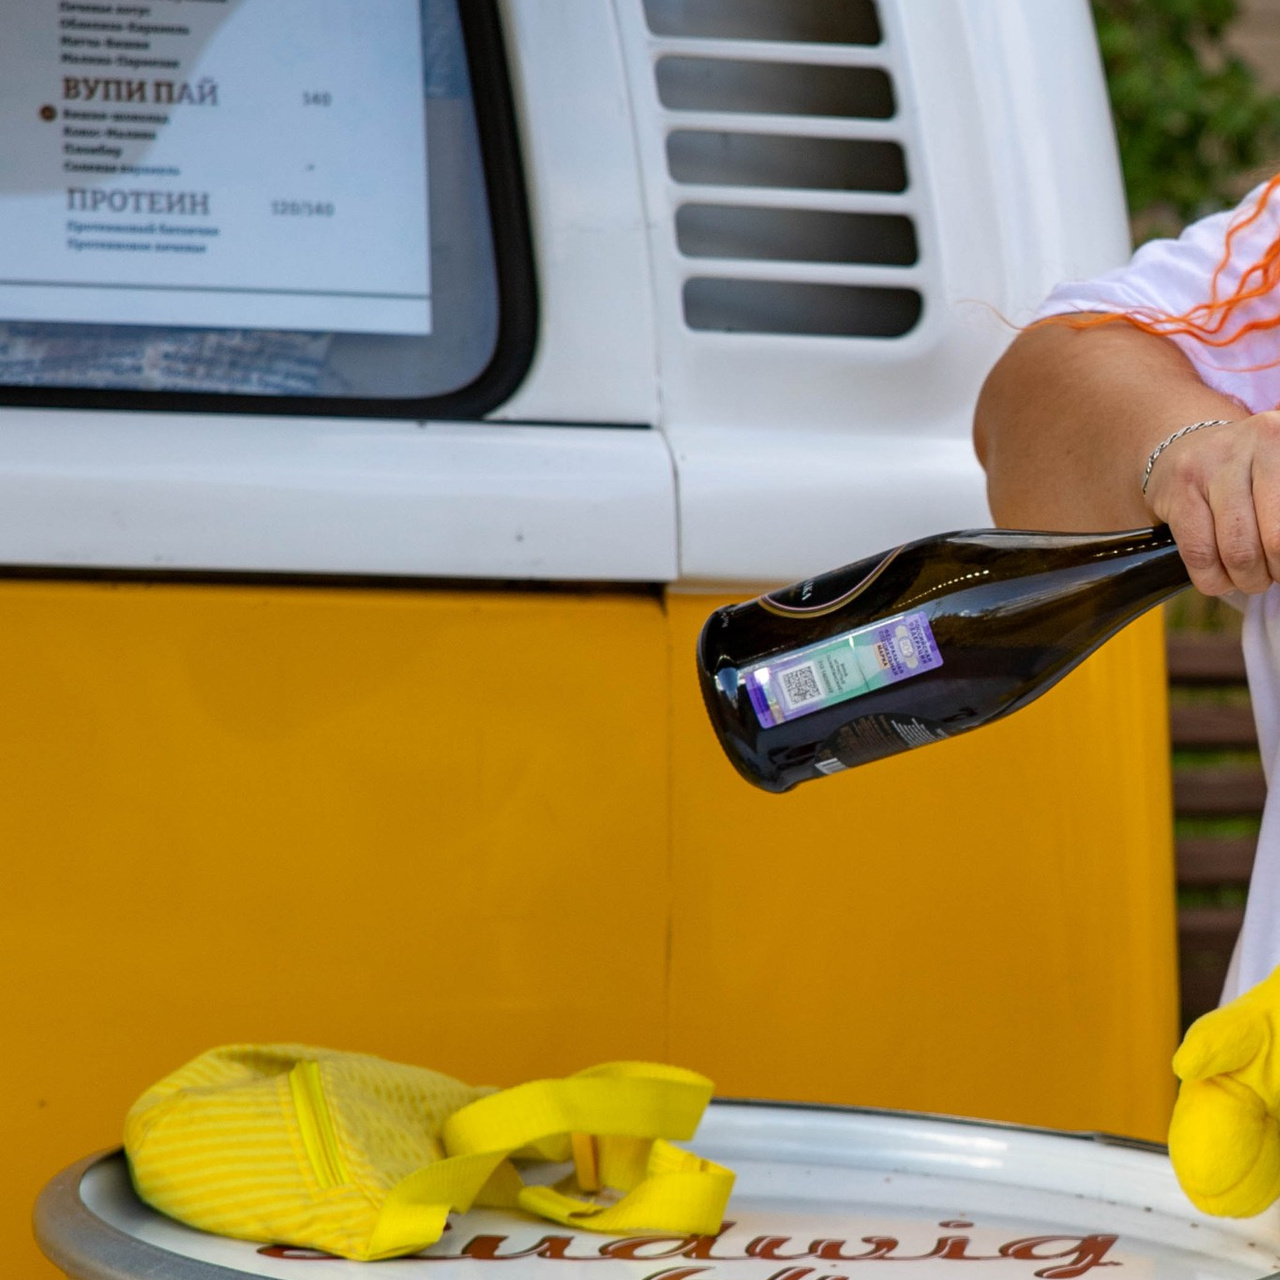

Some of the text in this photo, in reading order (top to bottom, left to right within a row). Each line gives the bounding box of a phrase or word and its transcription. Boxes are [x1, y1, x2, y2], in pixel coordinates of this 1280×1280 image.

[62, 76, 219, 107] ВУПИ ПАЙ
[66, 187, 211, 217] ПРОТЕИН
[256, 1220, 1123, 1280] udwig
